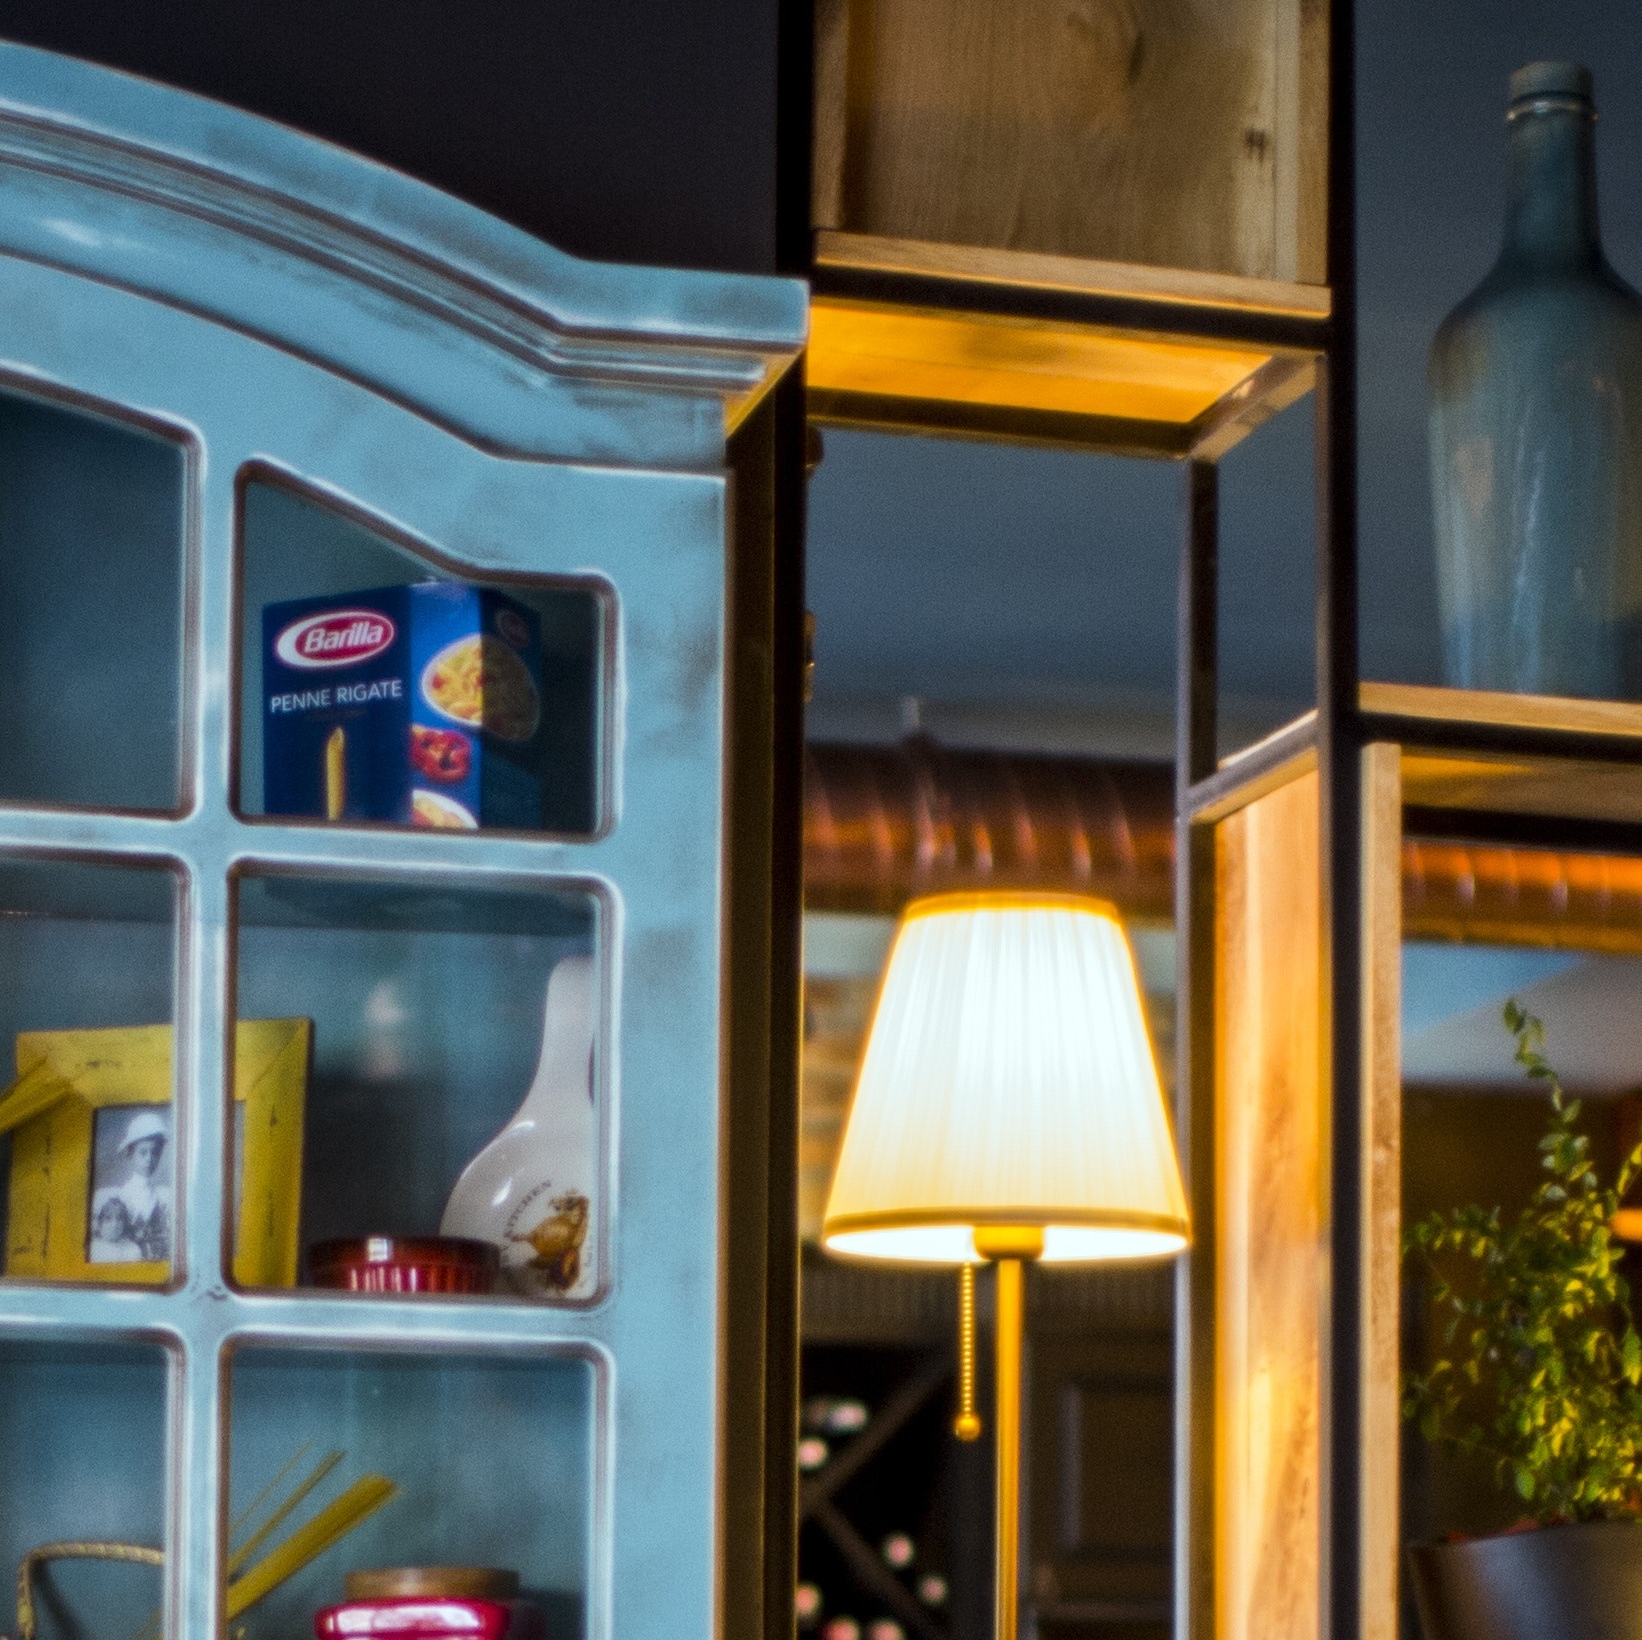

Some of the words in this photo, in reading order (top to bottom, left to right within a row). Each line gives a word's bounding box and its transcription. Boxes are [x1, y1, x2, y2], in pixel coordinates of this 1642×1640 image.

[303, 621, 384, 654] Barilla
[269, 691, 332, 714] PENNE
[336, 678, 404, 706] RIGATE
